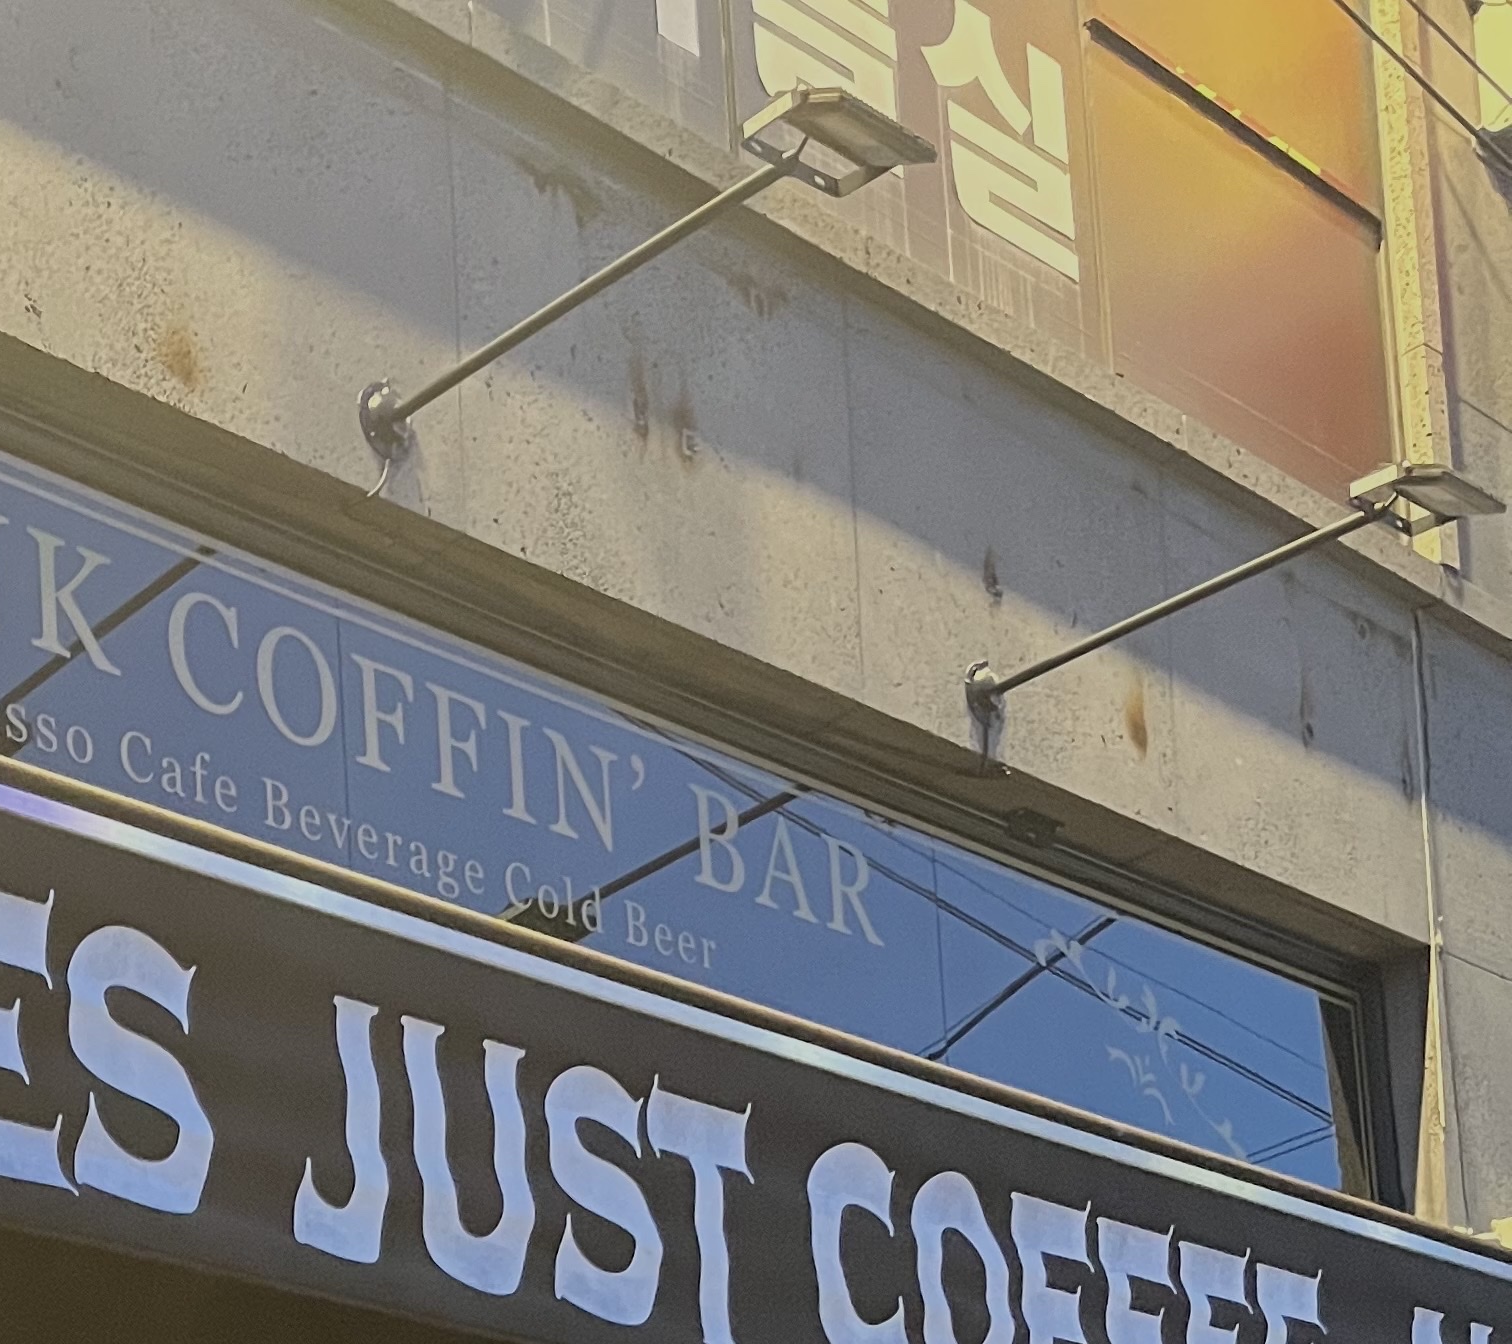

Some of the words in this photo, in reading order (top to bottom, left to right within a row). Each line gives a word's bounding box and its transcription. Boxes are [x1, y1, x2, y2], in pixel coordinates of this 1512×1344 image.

[119, 731, 239, 812] Cafe
[260, 777, 485, 904] Beverage
[504, 862, 604, 935] Cold
[624, 900, 716, 971] Beer
[691, 784, 885, 947] BAR
